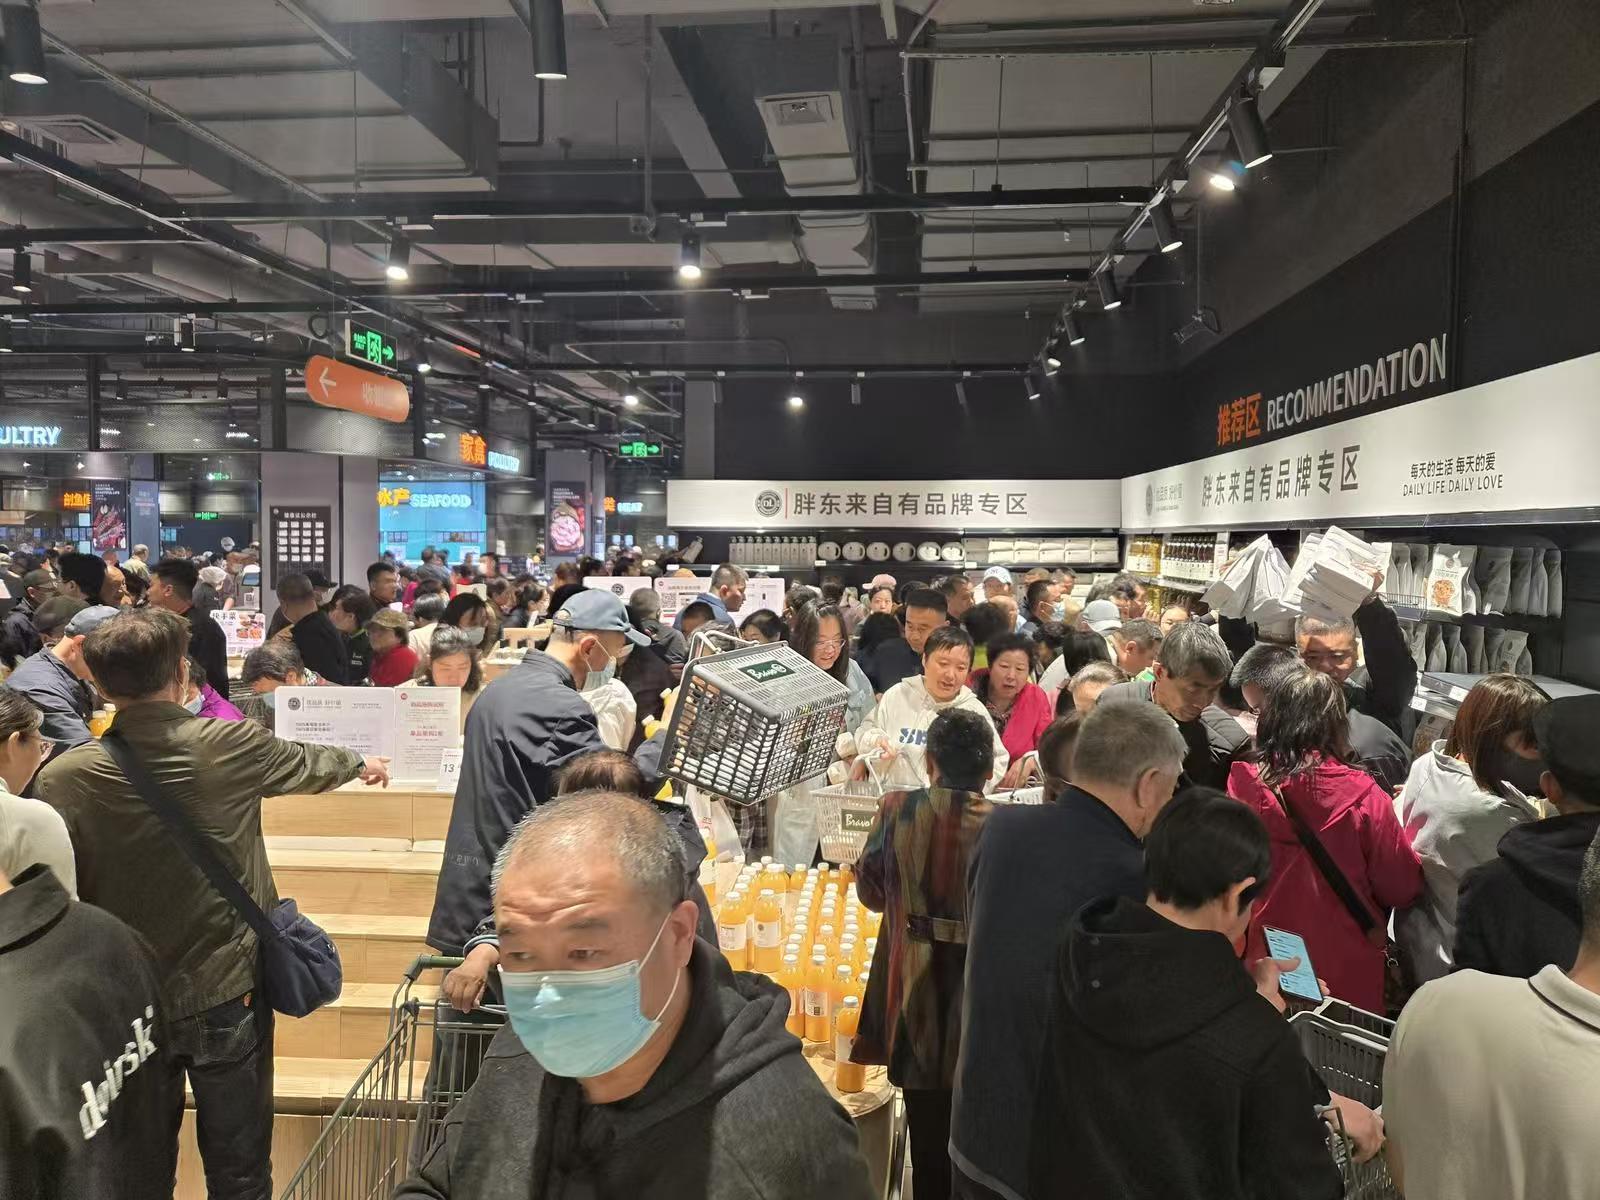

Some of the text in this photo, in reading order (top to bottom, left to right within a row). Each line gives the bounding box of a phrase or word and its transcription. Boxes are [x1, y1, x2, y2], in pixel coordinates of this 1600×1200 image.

[1217, 333, 1448, 447] 推荐区 RECOMMENDATION
[460, 432, 487, 466] 家禽
[1201, 444, 1361, 508] 胖东来自有品牌专区
[1411, 452, 1496, 479] 每天的生活 每天的爱
[377, 487, 472, 508] 水产 SEAFOOD
[1403, 474, 1504, 496] DAILY LIFE DAILY LOVE
[793, 491, 1029, 517] 胖东来自有品牌专区
[846, 813, 871, 828] Bravo
